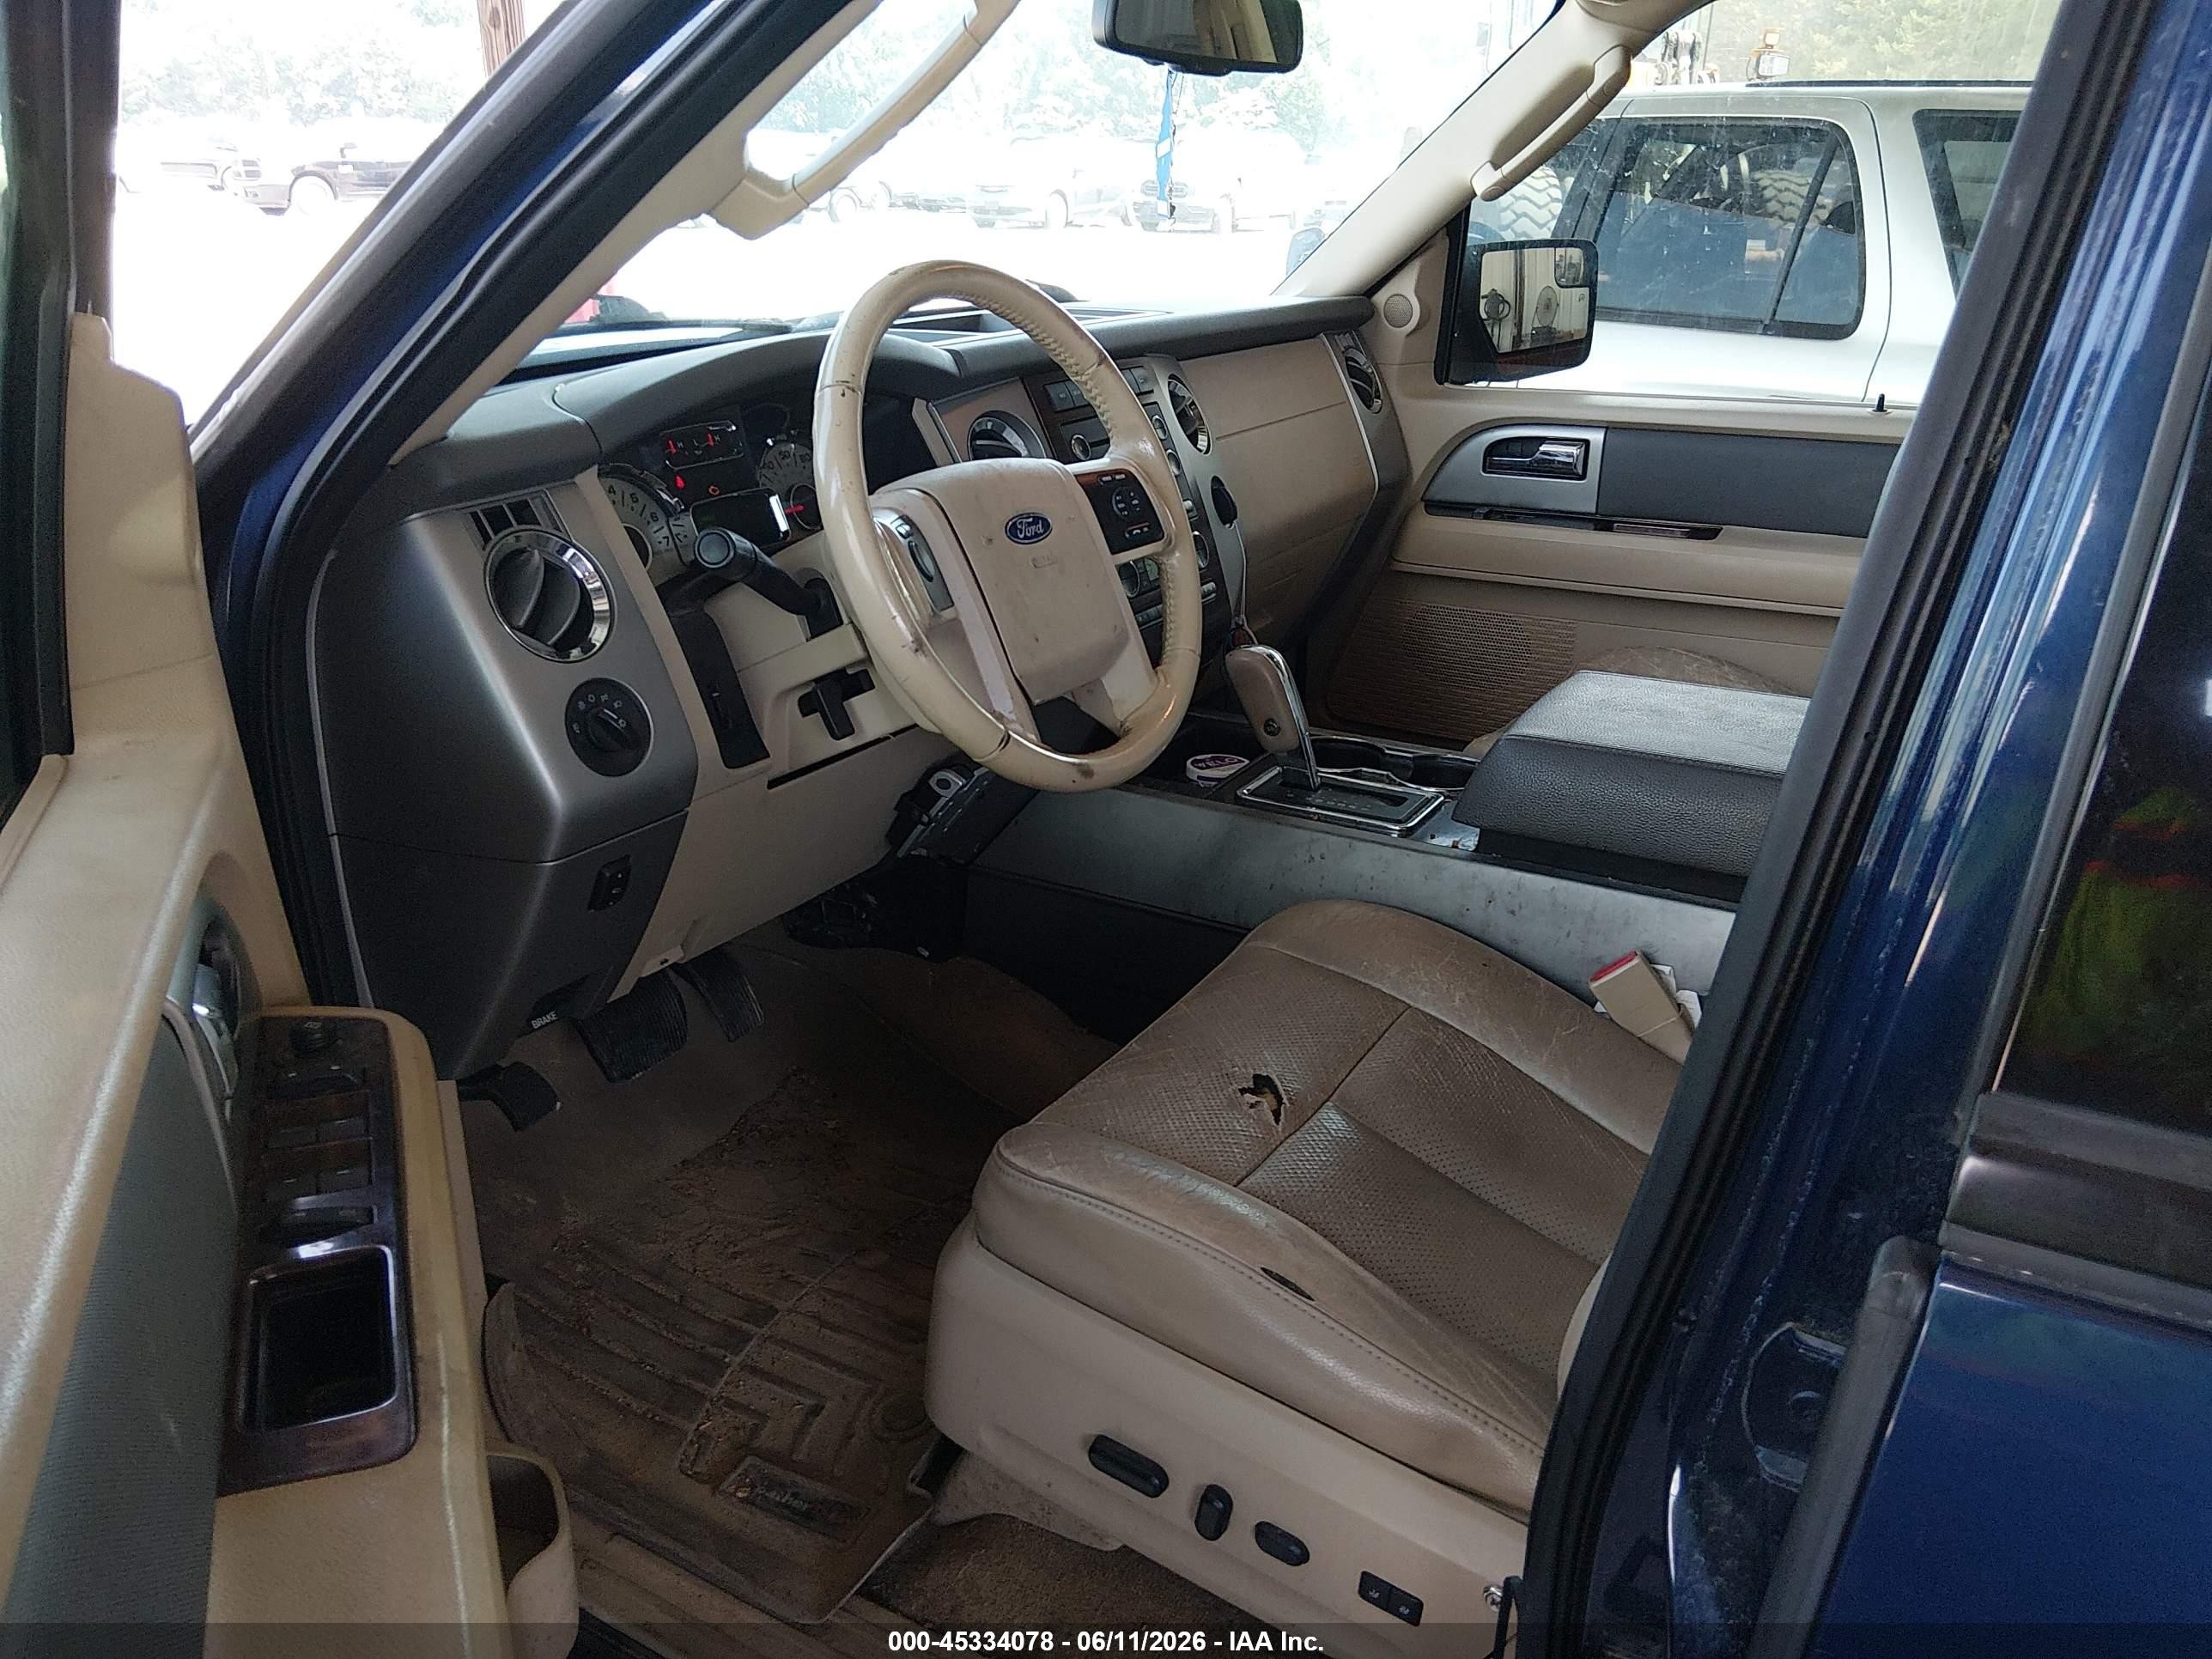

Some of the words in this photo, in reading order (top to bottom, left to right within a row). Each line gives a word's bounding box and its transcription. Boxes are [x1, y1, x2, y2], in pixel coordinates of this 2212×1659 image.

[608, 485, 617, 495] 4
[629, 492, 640, 503] 5
[649, 512, 659, 522] 6
[1016, 517, 1045, 539] Ford
[662, 535, 670, 546] 7
[531, 1010, 559, 1030] BRAKE
